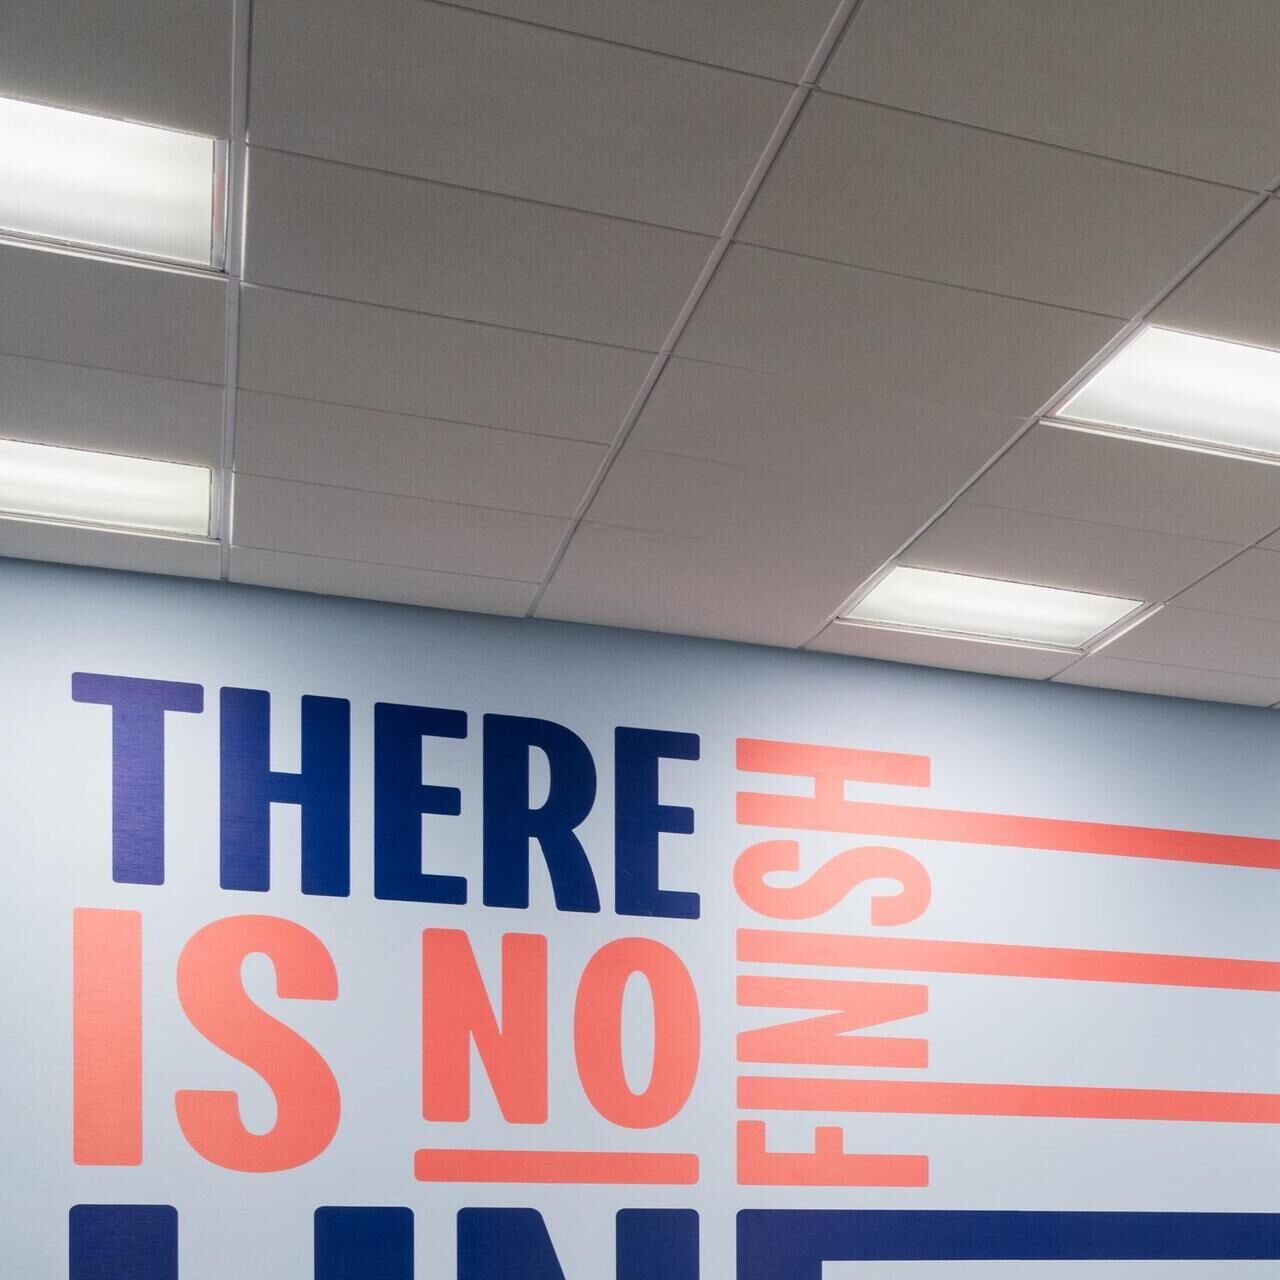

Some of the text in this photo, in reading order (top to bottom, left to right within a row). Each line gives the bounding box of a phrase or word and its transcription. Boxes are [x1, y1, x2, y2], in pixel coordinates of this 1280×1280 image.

[71, 672, 701, 919] THERE
[72, 907, 701, 1173] IS NO
[733, 737, 933, 1188] FINISH
